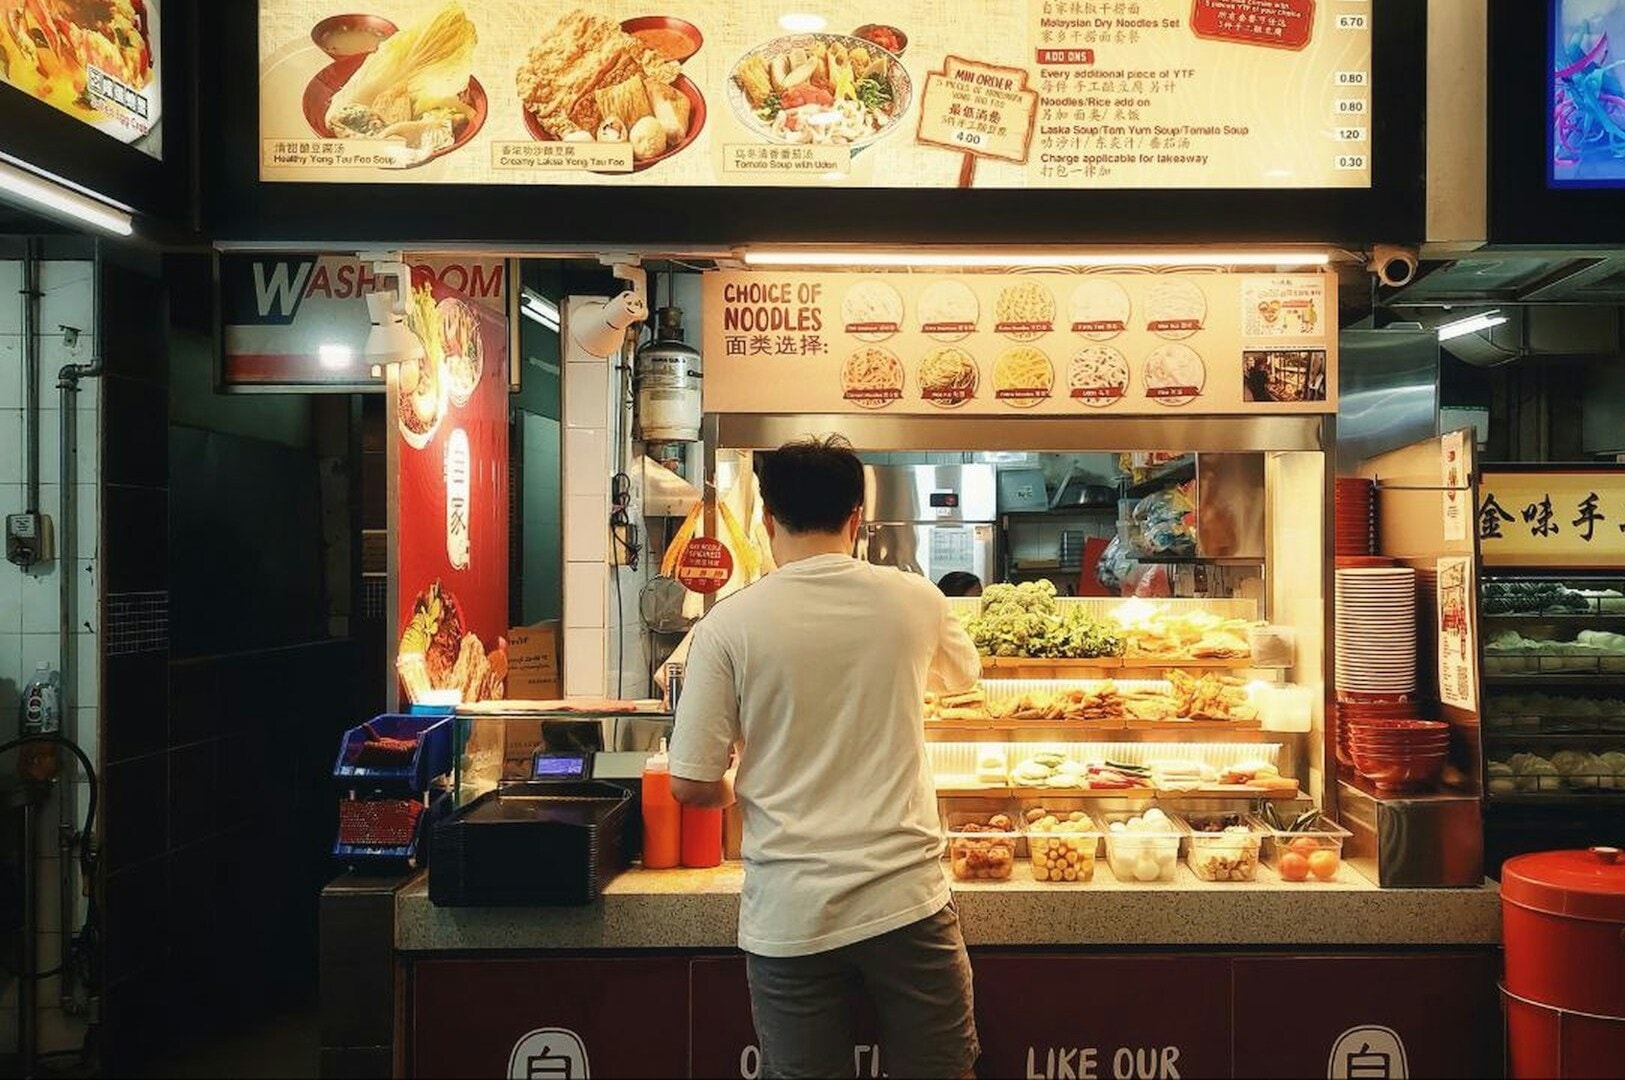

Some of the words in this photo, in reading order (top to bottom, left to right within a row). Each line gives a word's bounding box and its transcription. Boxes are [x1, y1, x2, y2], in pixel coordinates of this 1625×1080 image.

[1094, 18, 1113, 29] Dry
[1115, 18, 1159, 28] Noodles
[1161, 18, 1181, 28] Set
[1340, 17, 1364, 27] 6.70
[1044, 51, 1065, 62] ADD
[1067, 51, 1087, 62] ONS
[1040, 69, 1070, 80] Every
[1074, 69, 1125, 79] additional
[1127, 69, 1156, 80] piece
[1159, 69, 1170, 79] of
[1173, 70, 1195, 79] YTF
[1340, 74, 1363, 83] 0.80
[976, 74, 1014, 91] ORDER
[1114, 97, 1135, 107] add
[1137, 98, 1151, 107] on
[1340, 101, 1363, 111] 0.80
[1129, 125, 1152, 134] Yum
[1223, 125, 1249, 136] Soup
[310, 155, 334, 165] Yong
[336, 155, 352, 164] Tau
[354, 155, 371, 164] Foo
[566, 157, 588, 167] Yong
[608, 158, 625, 166] Foo
[735, 160, 768, 169] Tomato
[770, 160, 793, 170] Soup
[795, 161, 813, 169] with
[815, 161, 838, 169] Udon
[1040, 154, 1080, 165] Charge
[1083, 154, 1137, 165] applicable
[1139, 154, 1154, 163] for
[1157, 154, 1208, 165] takeaway
[1340, 157, 1363, 167] 0.30
[724, 282, 792, 304] CHOICE
[798, 282, 822, 304] OF
[724, 306, 823, 332] NOODLES
[1479, 487, 1625, 542] 金味手
[1026, 1046, 1098, 1080] LIKE
[1113, 1046, 1181, 1080] OUR
